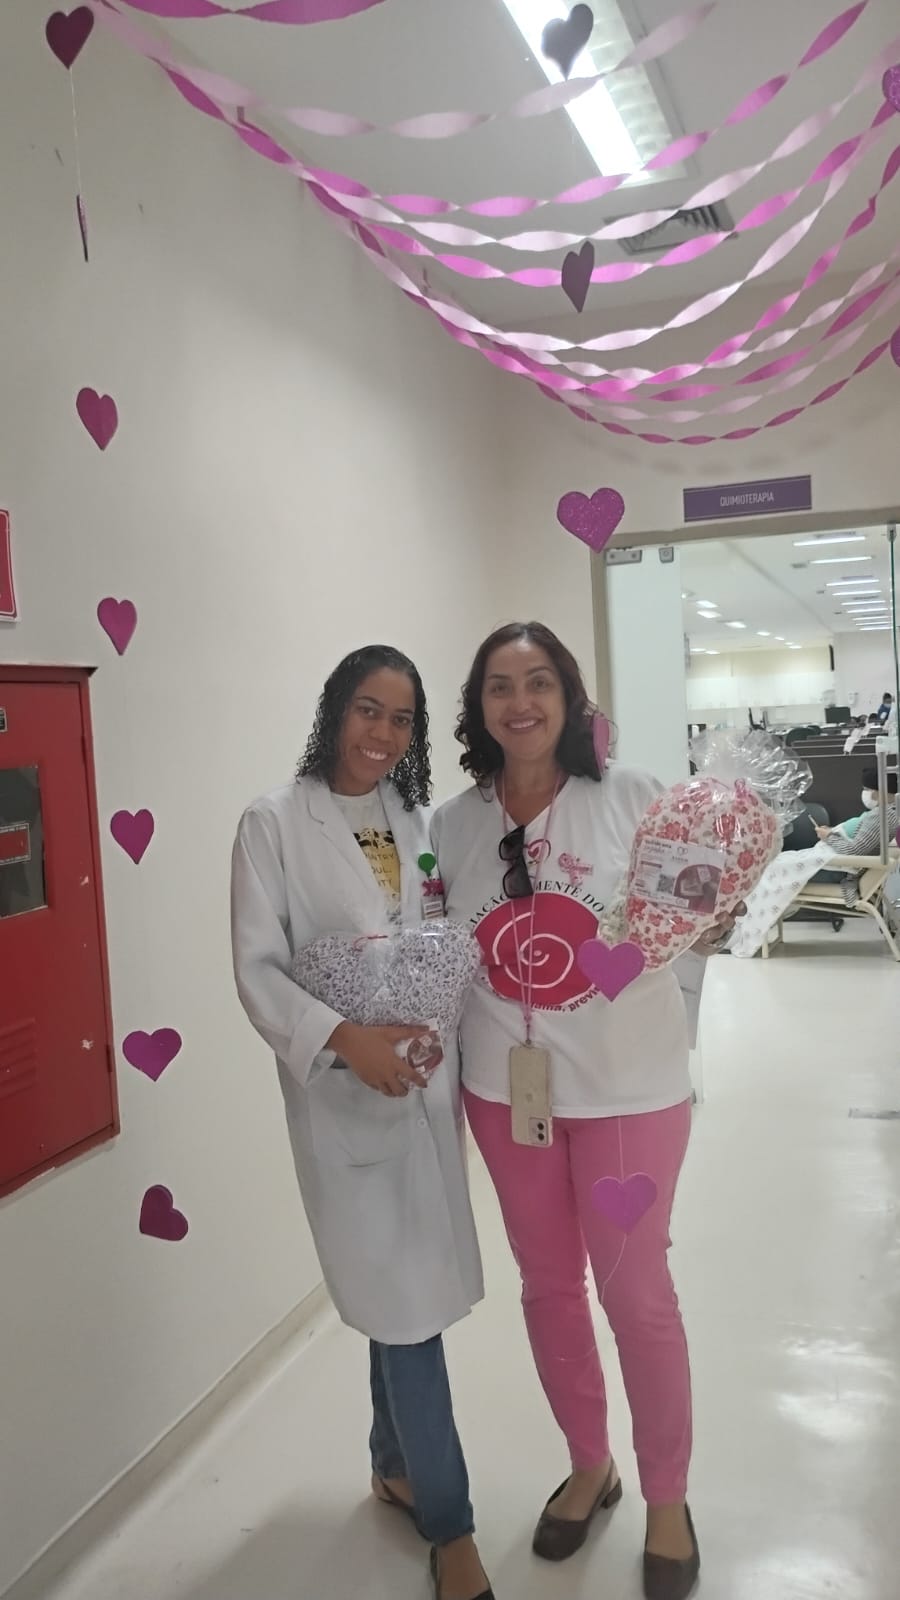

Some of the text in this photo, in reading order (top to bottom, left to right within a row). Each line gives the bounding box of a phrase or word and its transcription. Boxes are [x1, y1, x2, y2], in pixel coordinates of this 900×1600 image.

[720, 491, 775, 507] QUIMIOTERAPIA
[469, 893, 508, 926] IAÇÃO
[582, 893, 605, 913] DO
